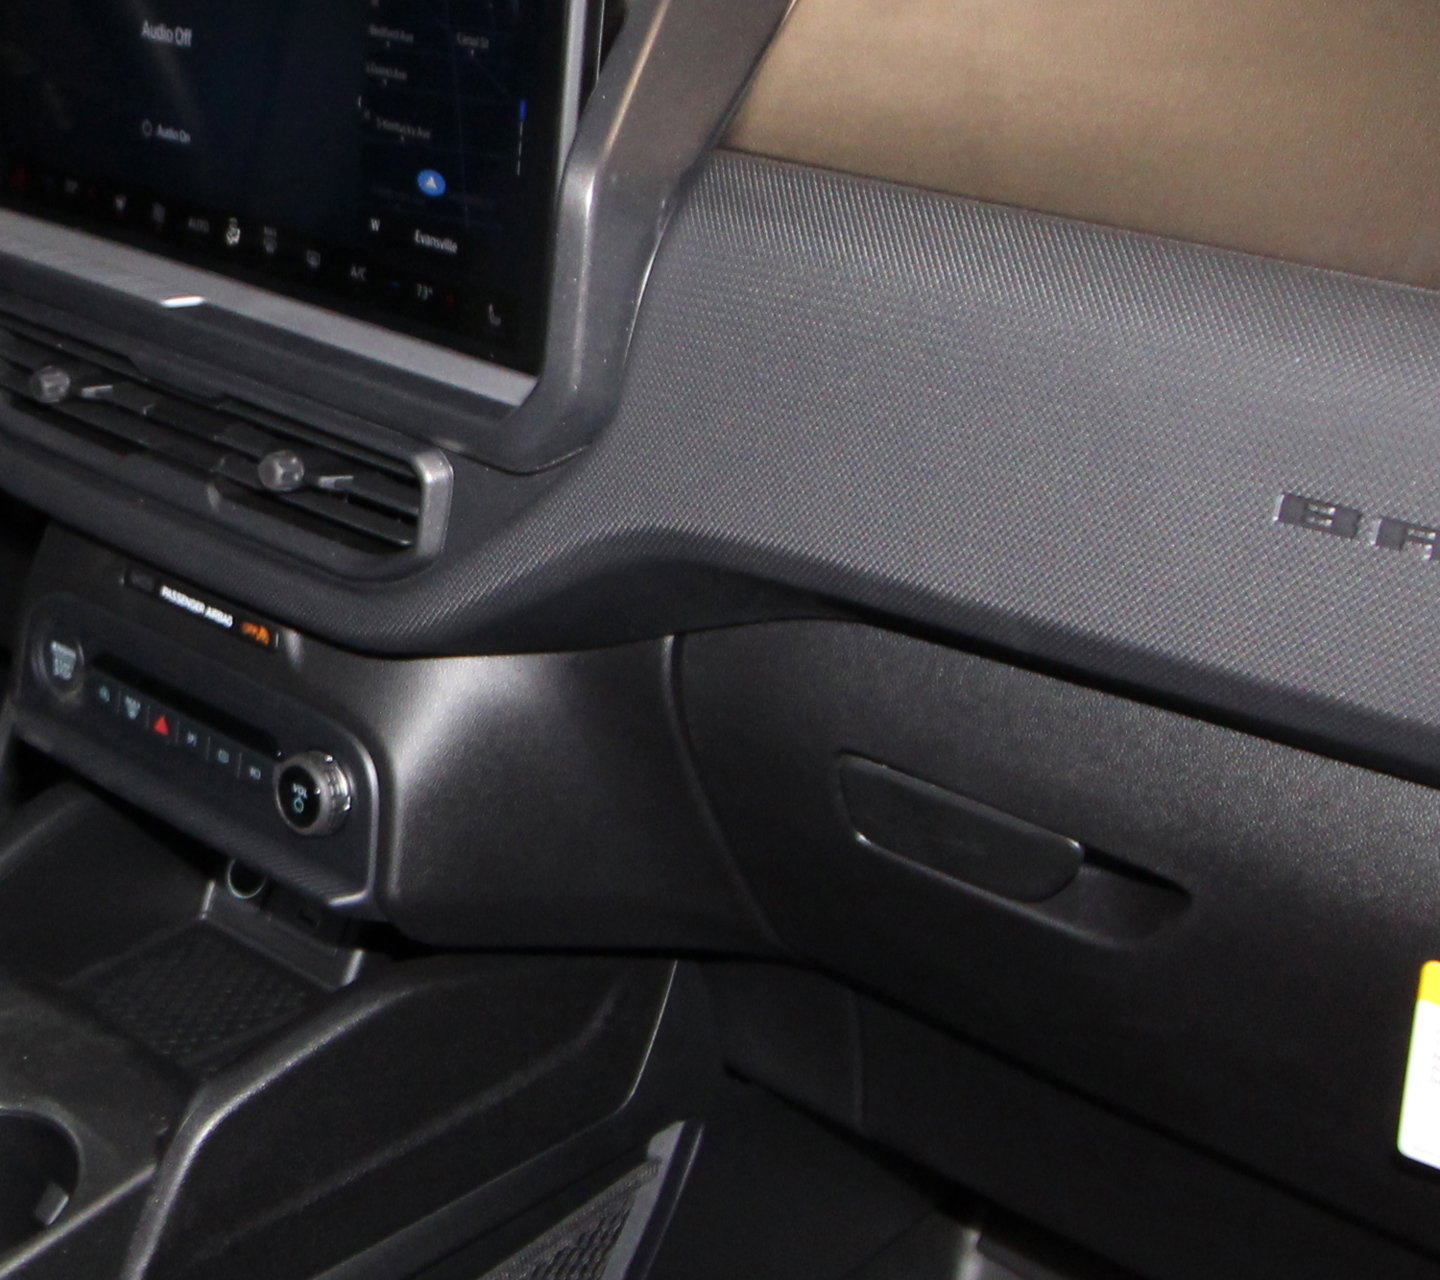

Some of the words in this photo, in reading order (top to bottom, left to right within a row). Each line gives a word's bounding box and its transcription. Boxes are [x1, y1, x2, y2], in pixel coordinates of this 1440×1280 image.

[141, 20, 173, 44] Audio
[175, 26, 192, 47] Off
[371, 218, 380, 231] W
[414, 229, 458, 254] Evansville
[160, 584, 206, 615] PASSENGER
[292, 783, 307, 799] VOL
